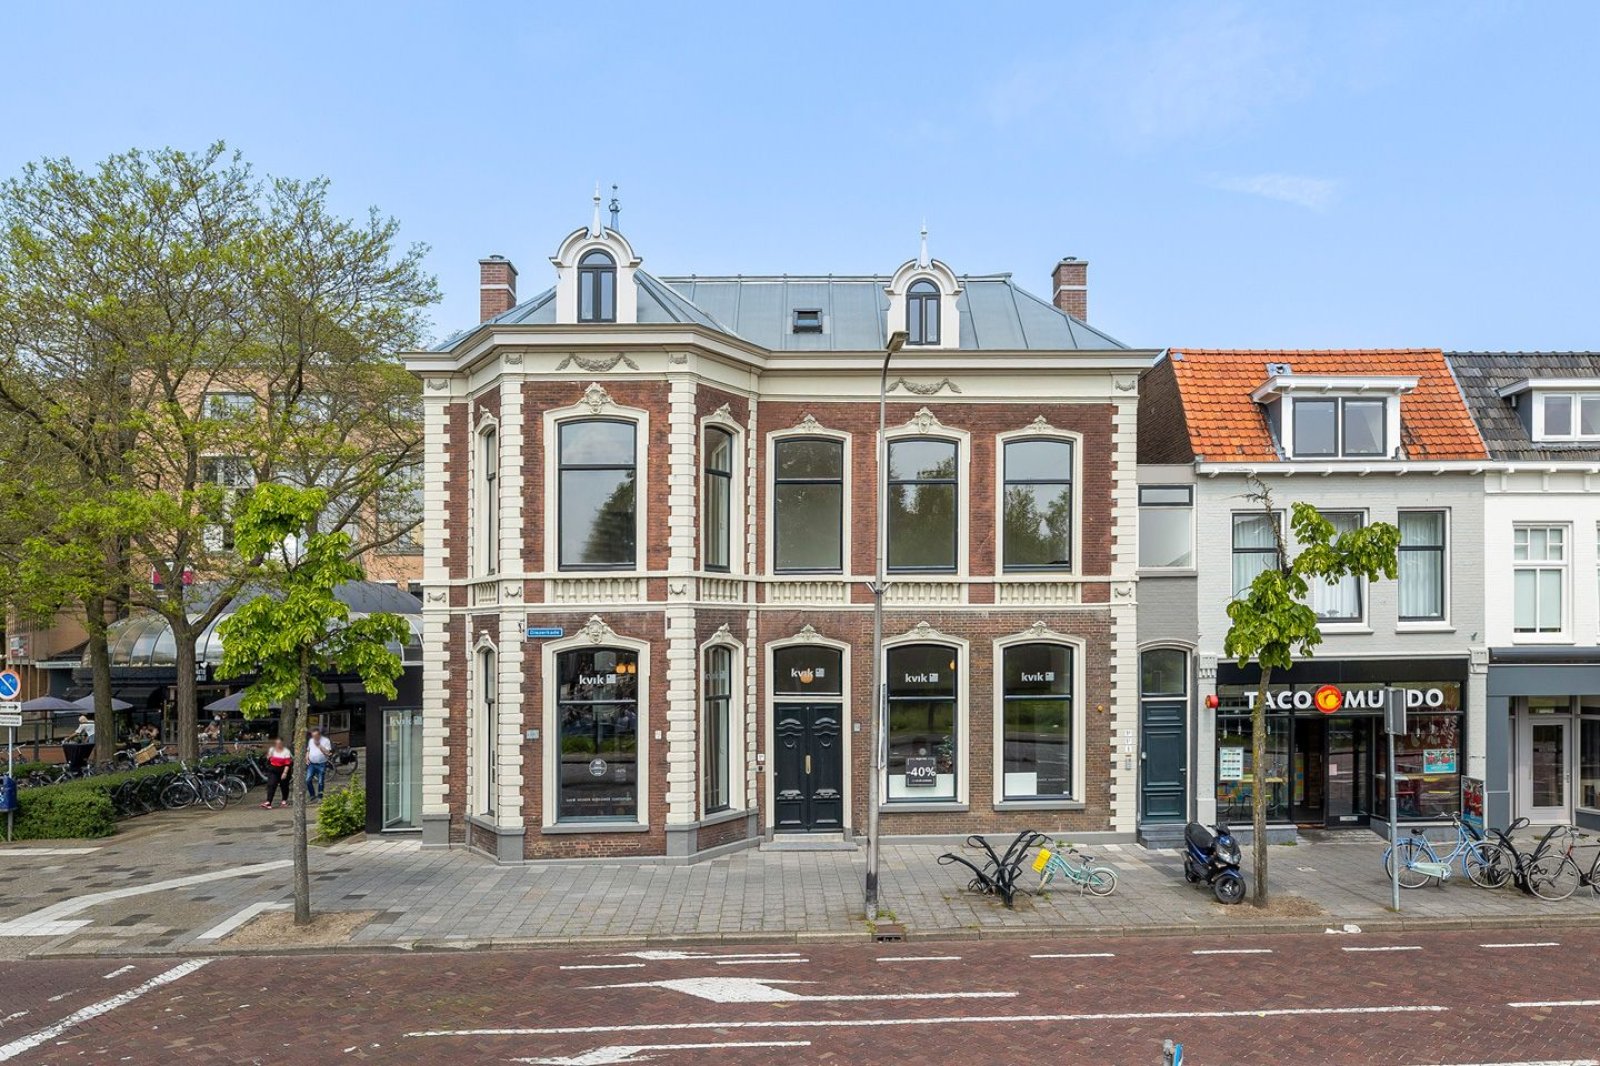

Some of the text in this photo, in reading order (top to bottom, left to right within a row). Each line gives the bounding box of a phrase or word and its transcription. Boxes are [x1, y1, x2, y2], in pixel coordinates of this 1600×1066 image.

[579, 674, 604, 685] kvik
[905, 673, 928, 683] kvik
[1021, 672, 1044, 682] kvik
[1243, 688, 1444, 709] TACO MUDO
[905, 766, 937, 777] -40%
